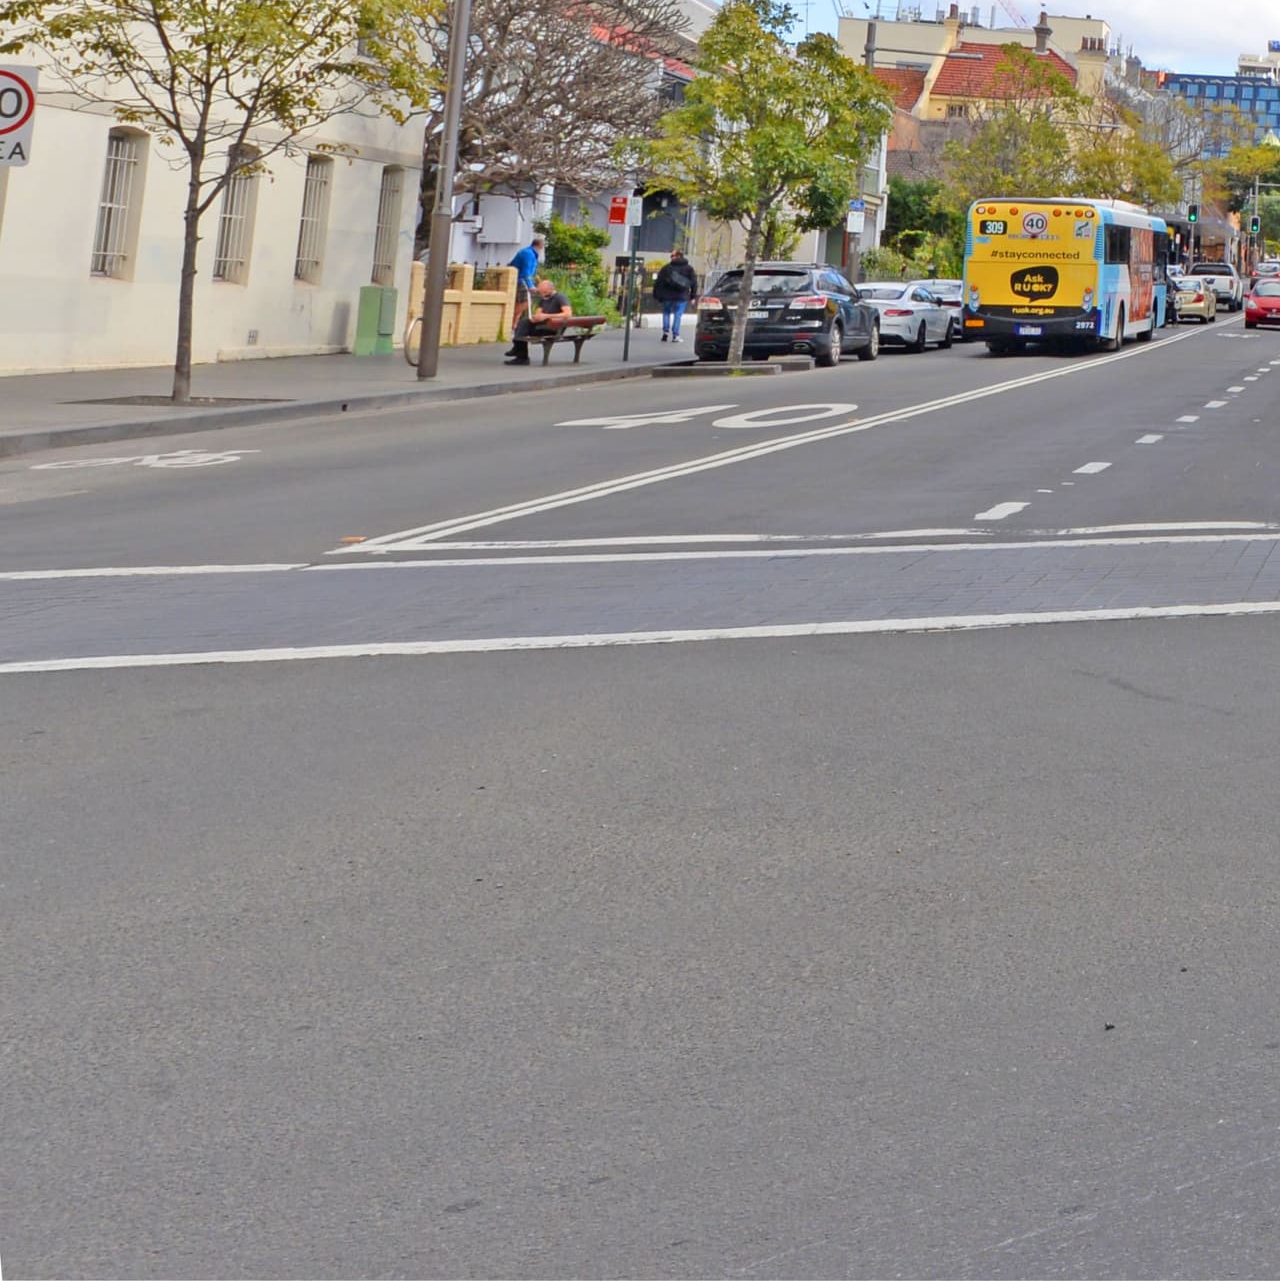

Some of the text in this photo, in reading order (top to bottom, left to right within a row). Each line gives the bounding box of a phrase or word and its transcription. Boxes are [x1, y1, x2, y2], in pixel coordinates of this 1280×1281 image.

[985, 221, 1004, 234] 309
[1026, 218, 1045, 230] 40
[991, 249, 1080, 260] #stayconnected
[1024, 274, 1044, 283] Ask
